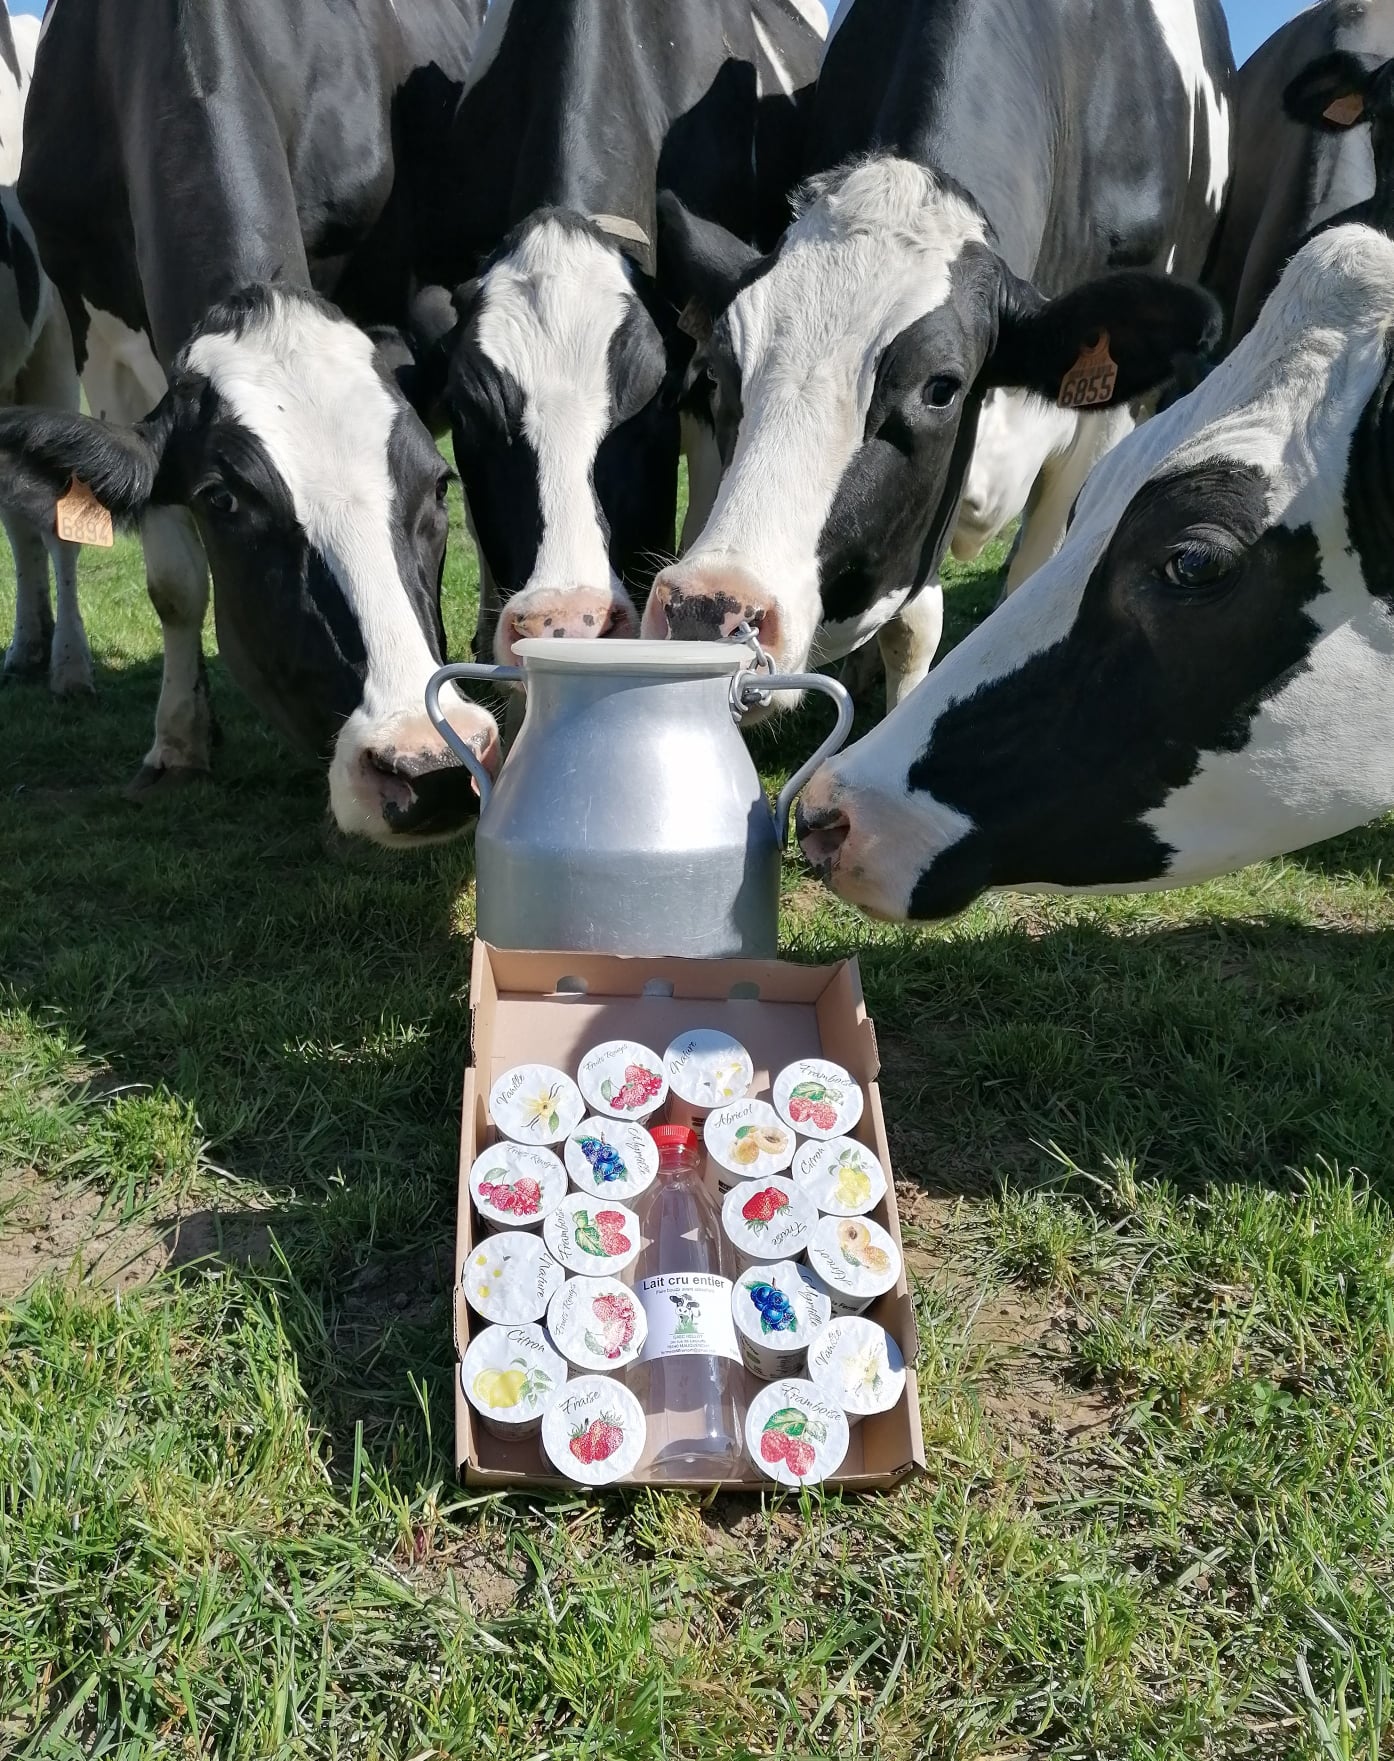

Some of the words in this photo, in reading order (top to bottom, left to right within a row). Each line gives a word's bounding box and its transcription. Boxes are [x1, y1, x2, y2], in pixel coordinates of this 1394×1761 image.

[1061, 370, 1114, 405] 6855
[670, 1040, 697, 1075] Nature
[496, 1073, 526, 1106] Vanille
[799, 1062, 855, 1088] Framboise
[714, 1103, 754, 1129] Abricot
[800, 1147, 825, 1175] Citron
[556, 1206, 574, 1262] Framboise
[771, 1221, 808, 1247] Fraise
[536, 1251, 554, 1298] Nature
[643, 1277, 664, 1291] Lait
[668, 1276, 689, 1286] cru
[692, 1276, 725, 1289] entier
[814, 1248, 853, 1286] Abricot
[506, 1329, 545, 1353] Citron
[814, 1328, 842, 1367] Vanille
[560, 1390, 601, 1415] Fraise
[781, 1382, 842, 1421] Framboise
